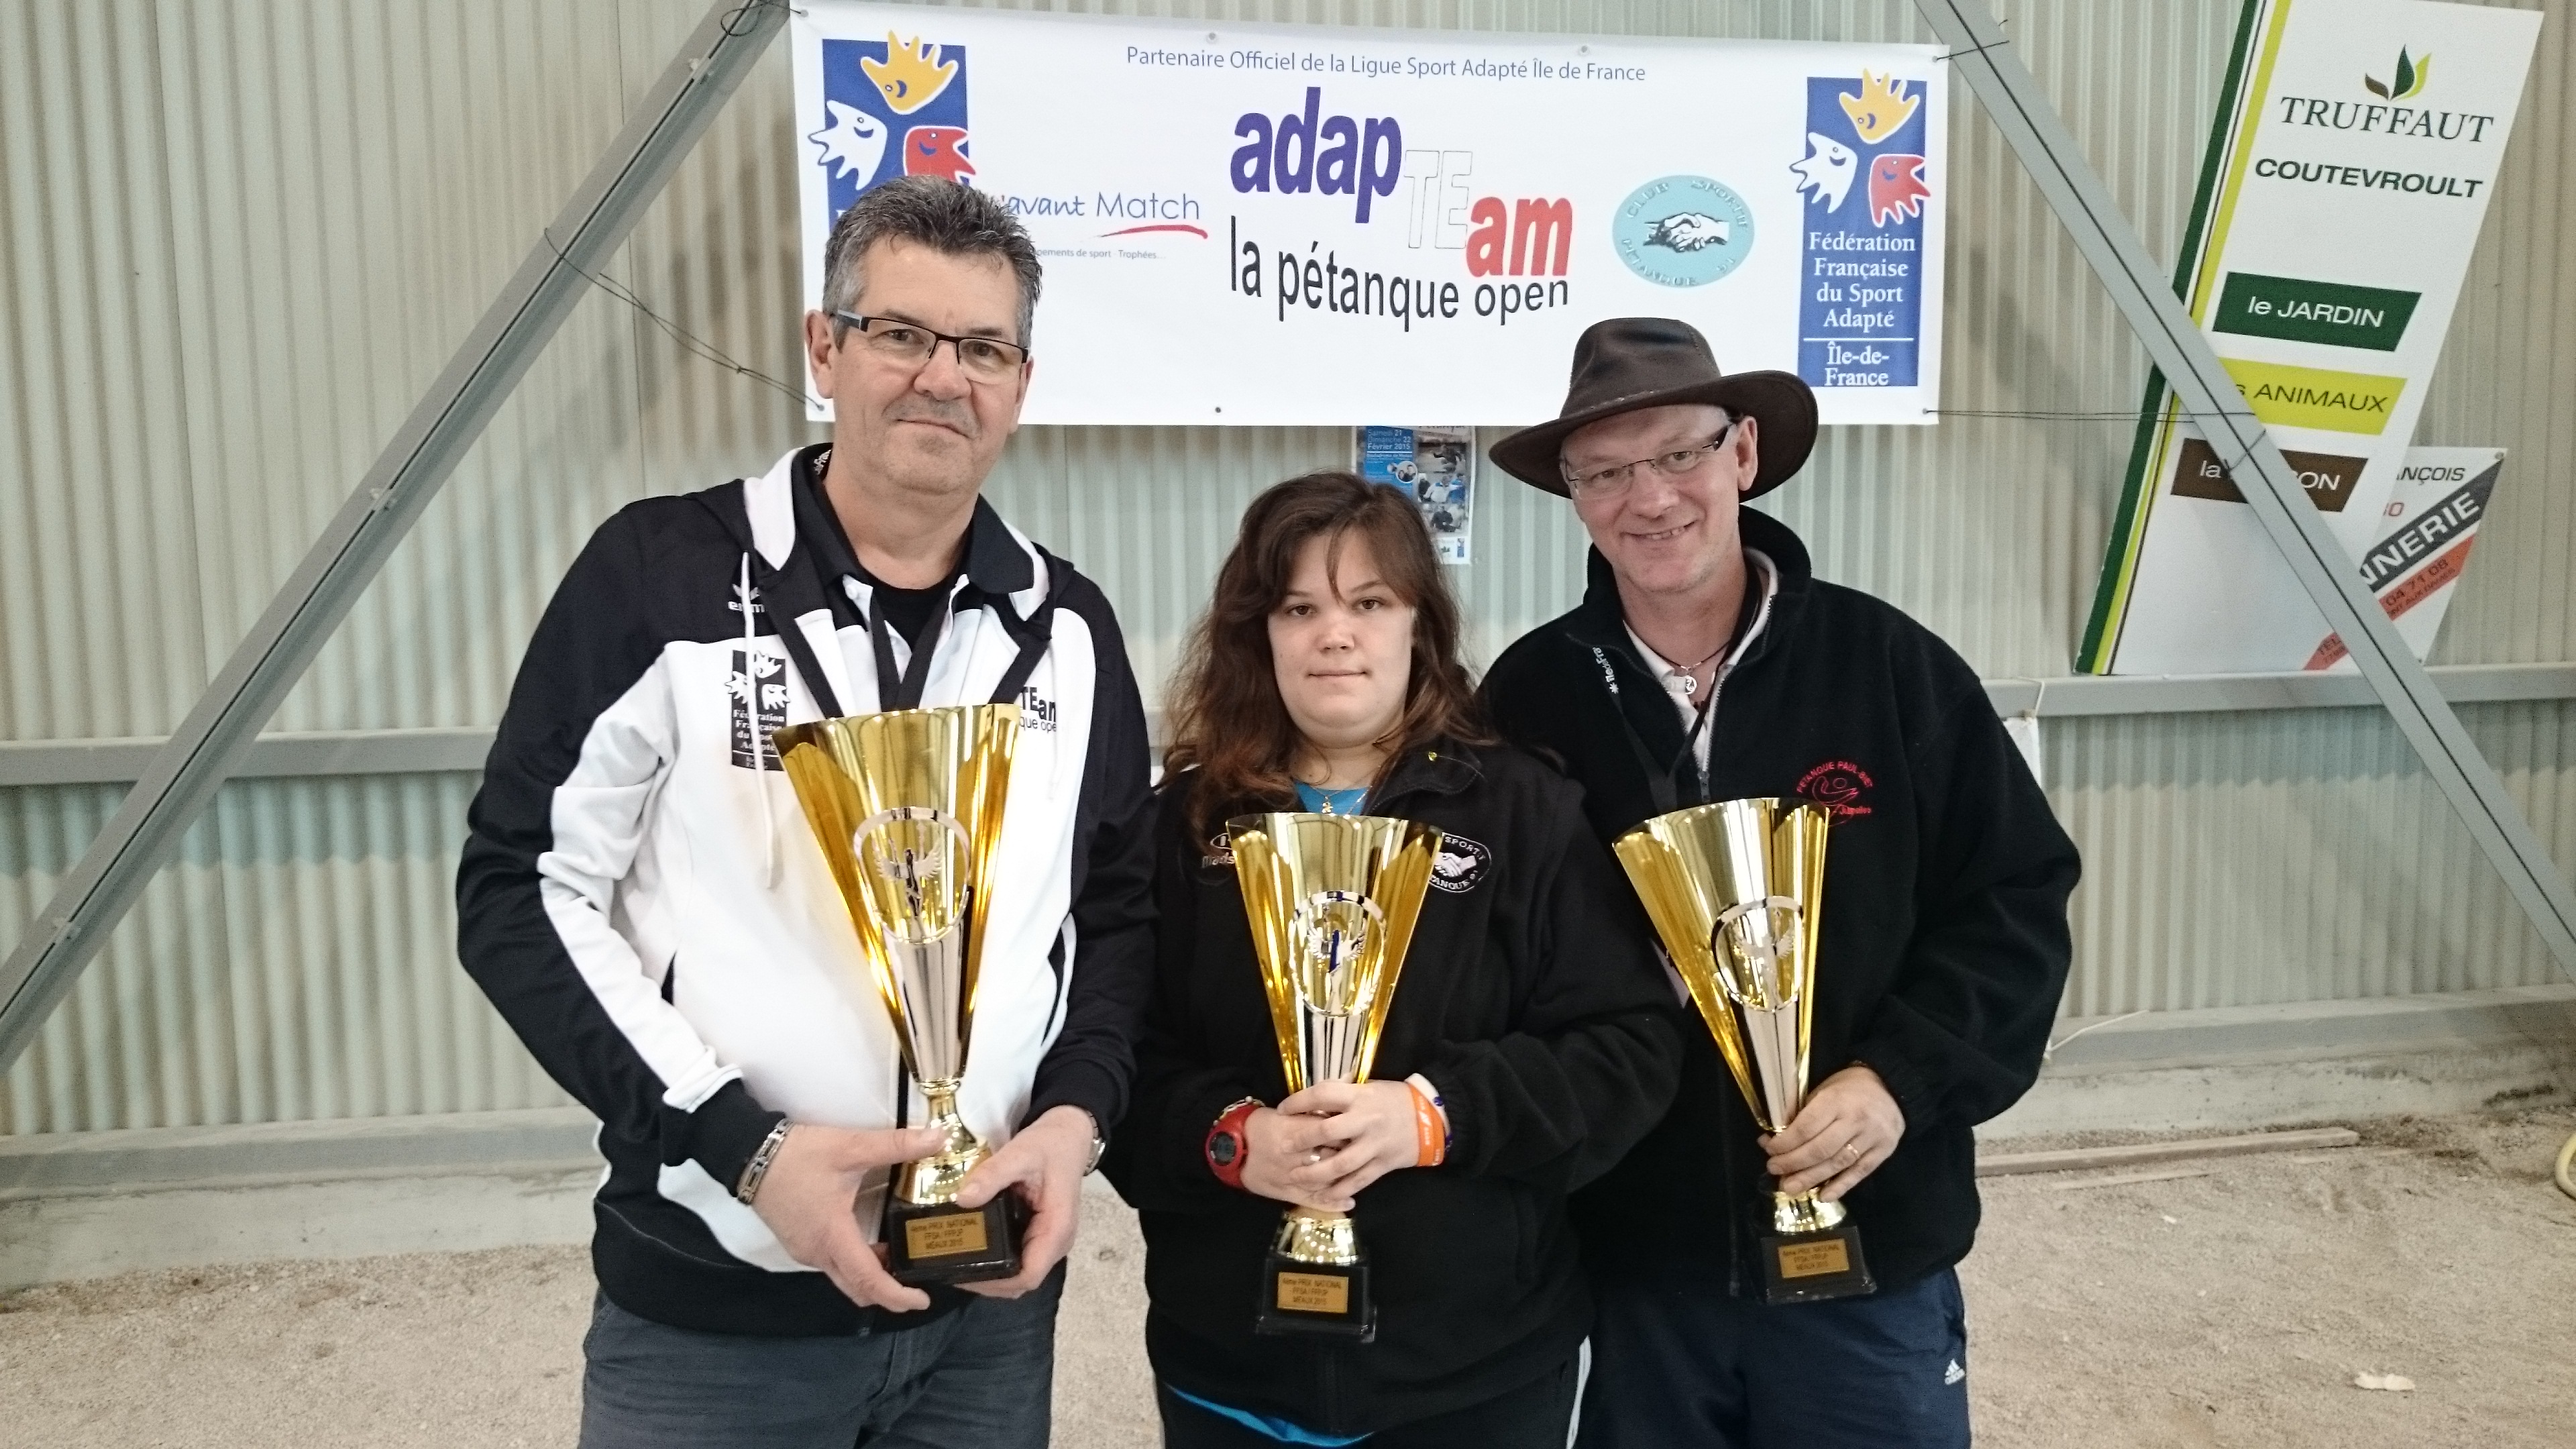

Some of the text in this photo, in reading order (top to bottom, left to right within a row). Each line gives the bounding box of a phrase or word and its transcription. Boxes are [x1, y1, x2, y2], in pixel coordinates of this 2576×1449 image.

[1127, 46, 1646, 81] Partenaire Officiel de la Ligue Sport Adapté Île de France
[2280, 96, 2494, 143] TRUFFAUT
[2255, 158, 2483, 198] COUTEVROULT
[1096, 191, 1199, 220] Match
[1077, 249, 1087, 257] de
[1090, 249, 1112, 258] sport
[1809, 231, 1916, 251] Fédération
[1230, 215, 1568, 332] la pétanque open
[1814, 257, 1909, 280] Française
[1816, 282, 1904, 307] du Sport
[1823, 307, 1895, 333] Adapté
[2247, 296, 2384, 328] le JARDIN
[1824, 367, 1889, 386] France
[2253, 384, 2388, 413] ANIMAUX
[2199, 460, 2222, 479] la
